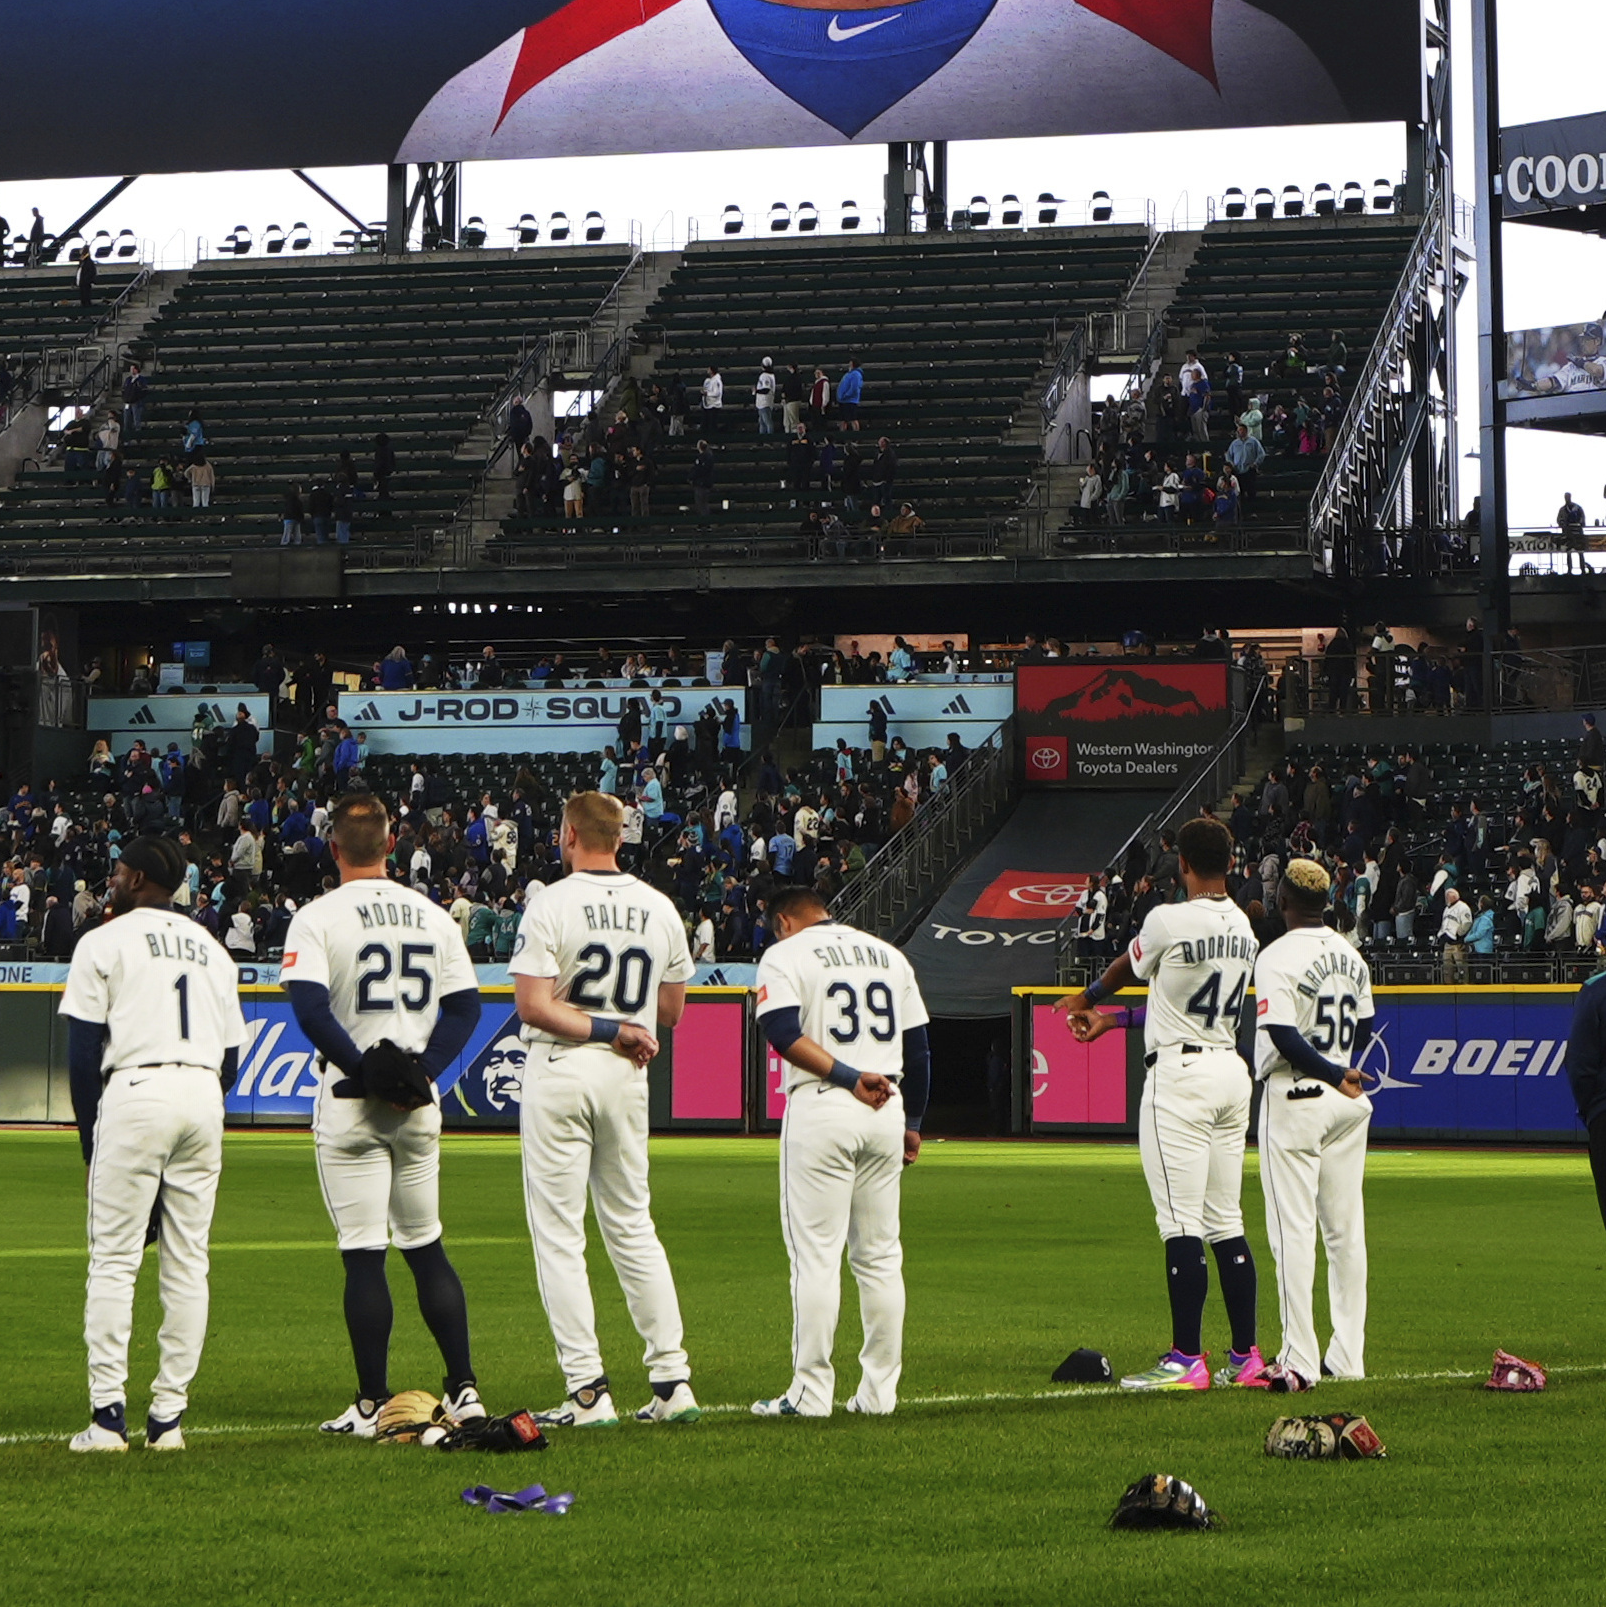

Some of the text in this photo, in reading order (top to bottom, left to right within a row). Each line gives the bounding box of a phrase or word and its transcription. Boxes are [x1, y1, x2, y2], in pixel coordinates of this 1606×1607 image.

[398, 697, 519, 721] J-ROD
[1076, 743, 1132, 755] Western
[1076, 761, 1178, 776] Toyota Dealers
[354, 903, 427, 931] MOORE
[582, 904, 650, 936] RALEY
[145, 933, 208, 966] BLISS
[813, 945, 890, 969] SOLANO
[356, 941, 436, 1014] 25
[566, 942, 654, 1015] 20
[172, 971, 191, 1043] 1
[825, 979, 896, 1045] 39
[1186, 970, 1247, 1032] 44
[1311, 994, 1359, 1054] 56
[1410, 1039, 1568, 1076] BOEI
